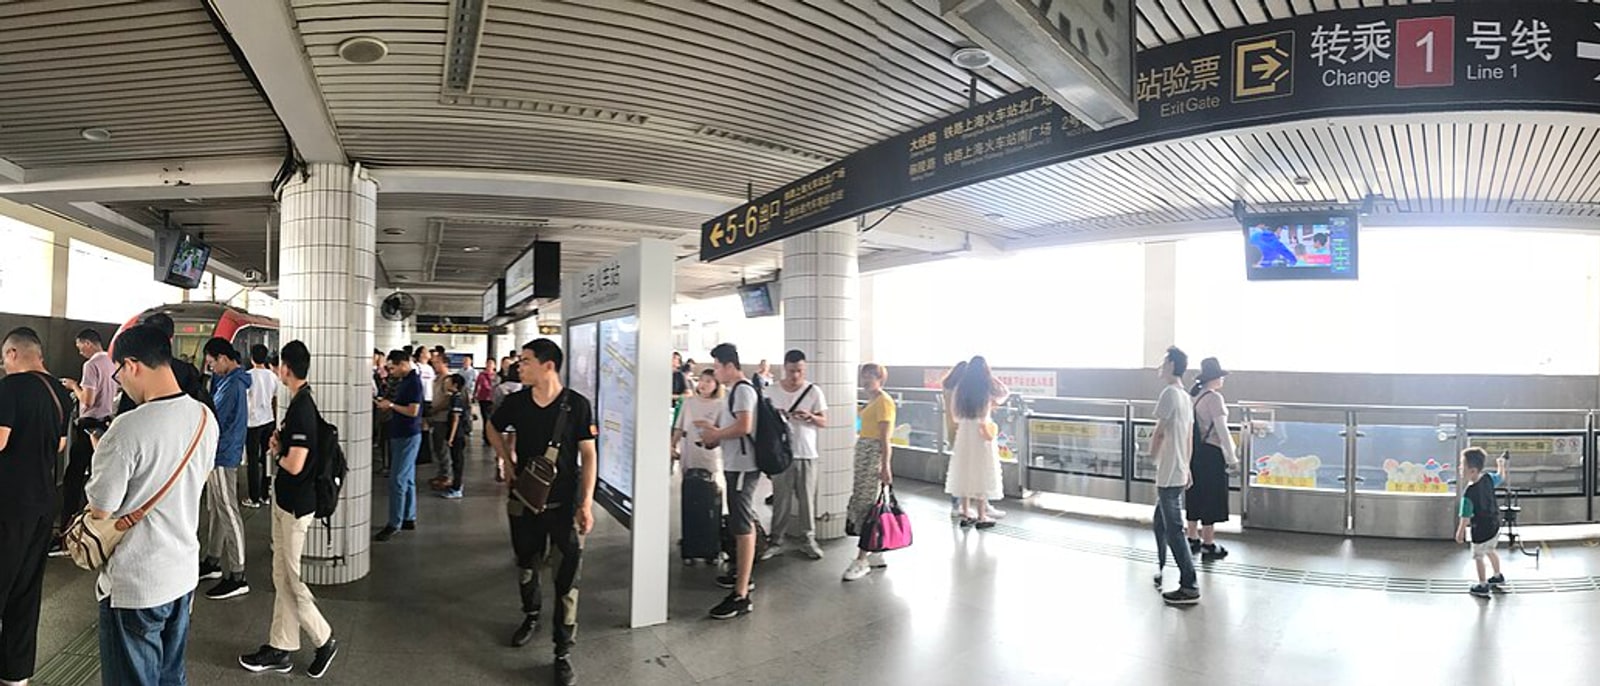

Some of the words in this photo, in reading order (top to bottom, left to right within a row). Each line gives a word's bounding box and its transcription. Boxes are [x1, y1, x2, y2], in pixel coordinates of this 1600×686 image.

[1310, 21, 1391, 66] 转乘
[1416, 31, 1435, 73] 1
[1466, 19, 1553, 62] 号线
[1136, 55, 1221, 101] 站验票
[1322, 69, 1391, 88] Change
[1467, 65, 1503, 80] Line
[1510, 64, 1518, 78] 1
[1160, 102, 1184, 117] Exit
[1186, 95, 1220, 112] Gate
[725, 205, 758, 244] 5-6
